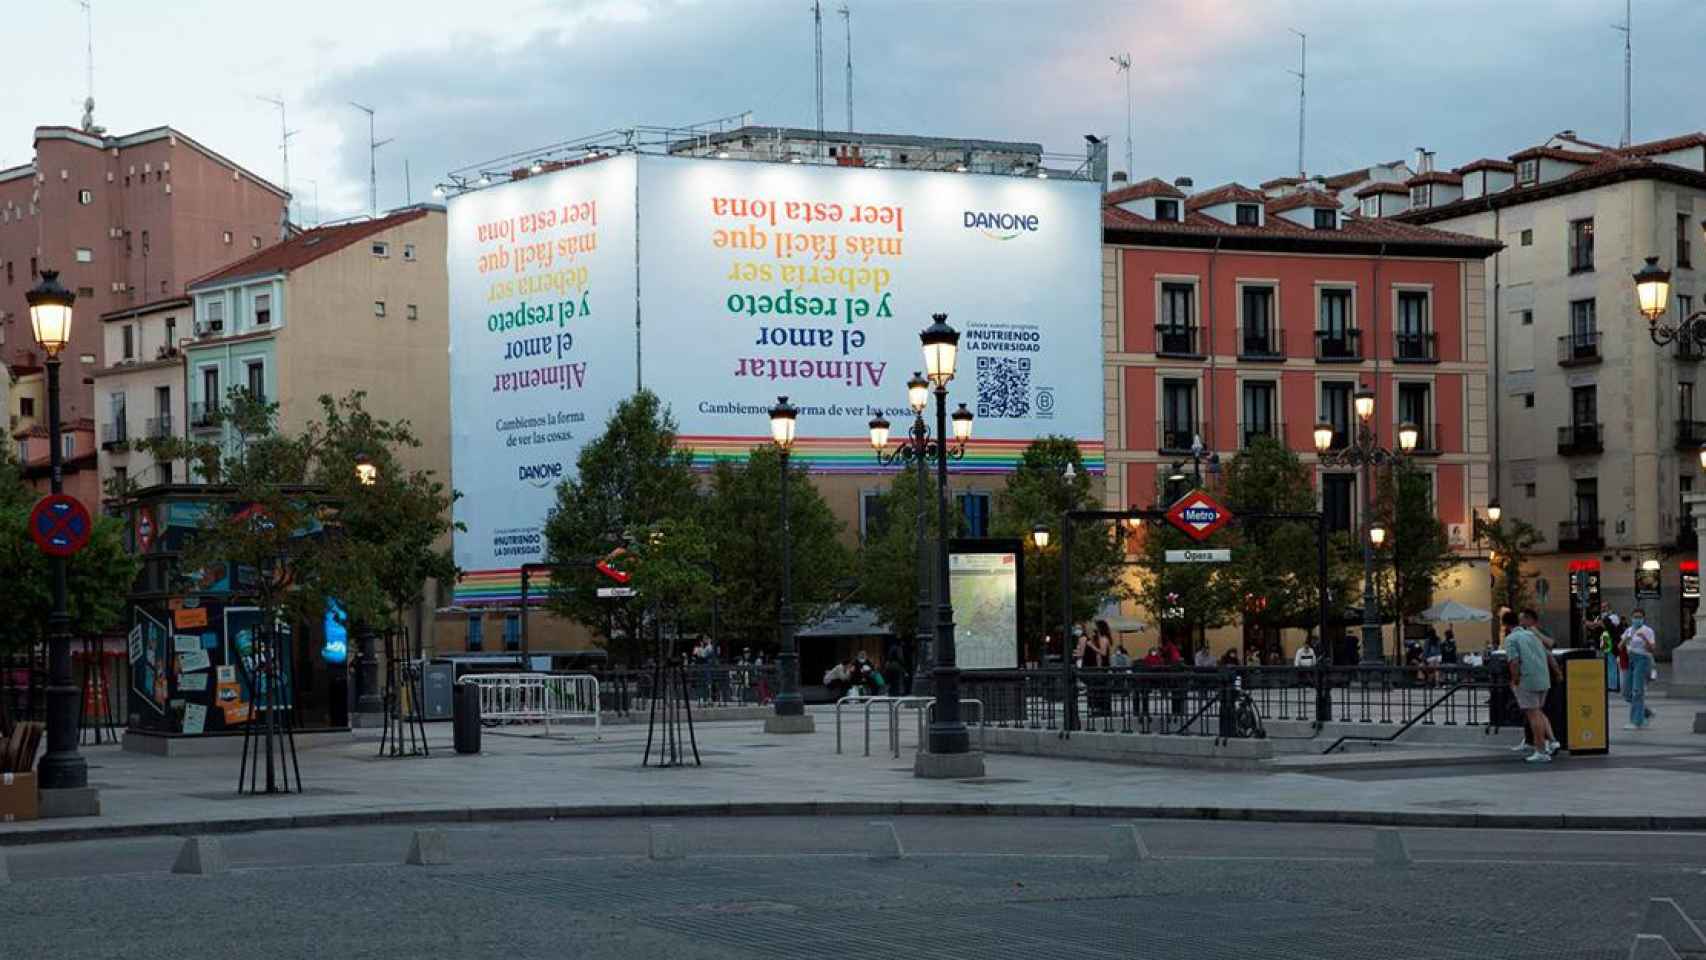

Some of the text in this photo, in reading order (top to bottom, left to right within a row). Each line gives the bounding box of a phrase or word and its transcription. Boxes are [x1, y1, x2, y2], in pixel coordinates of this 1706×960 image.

[477, 200, 597, 243] leer esta lona
[712, 197, 904, 232] leer esta lona
[479, 232, 597, 274] más fácil que
[713, 224, 903, 262] más fácil que
[728, 260, 890, 293] debería ser
[487, 281, 513, 303] ser
[727, 289, 892, 324] y el respeto
[488, 290, 591, 332] y el respeto
[504, 332, 573, 360] el amor
[756, 326, 866, 355] el amor
[966, 330, 1040, 341] #NUTRIENDO
[967, 341, 1040, 352] LA DIVERSIDAD
[493, 362, 587, 392] Alimentar
[735, 358, 887, 387] Alimentar
[557, 410, 585, 425] forma
[828, 403, 843, 416] de
[846, 406, 863, 417] ver
[506, 432, 518, 447] de
[533, 432, 545, 444] las
[1186, 509, 1214, 520] Metro
